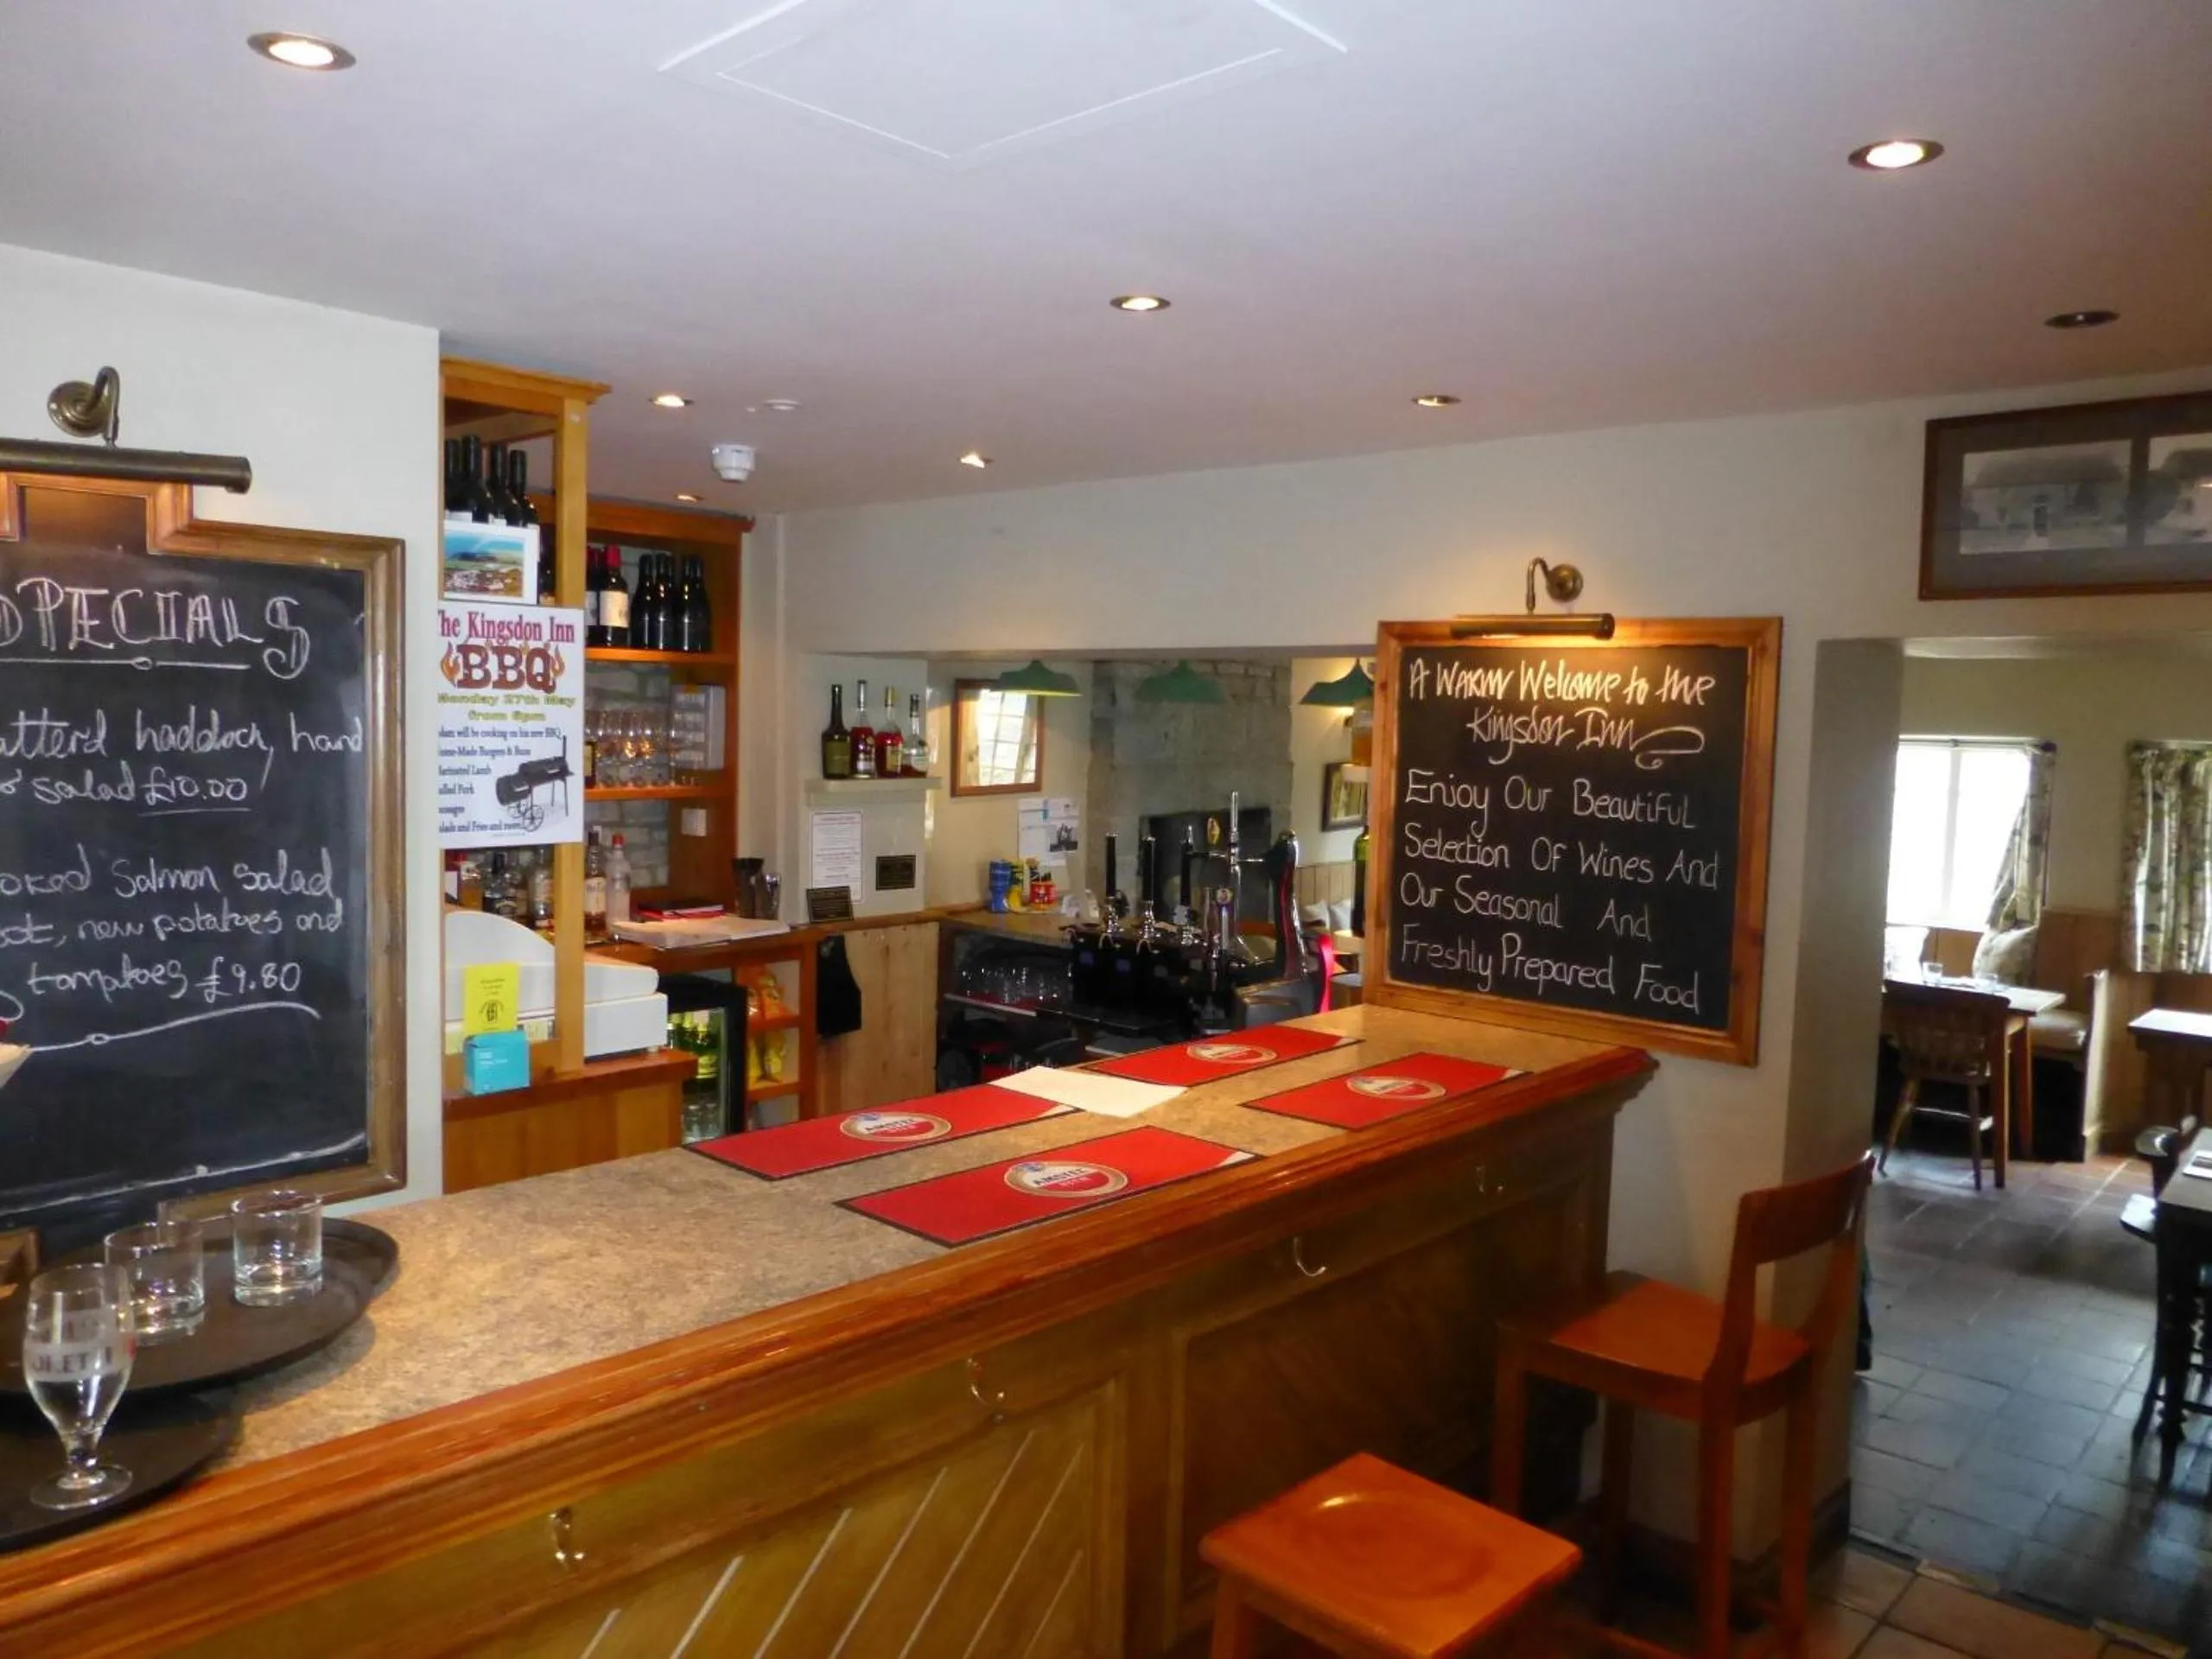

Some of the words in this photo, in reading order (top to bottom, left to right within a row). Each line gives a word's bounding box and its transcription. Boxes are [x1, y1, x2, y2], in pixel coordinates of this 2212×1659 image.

[467, 611, 543, 645] Kingsdon
[549, 615, 575, 643] Inn
[455, 644, 557, 694] BBQ
[1409, 658, 1430, 701] A
[1519, 659, 1622, 703] Welcome
[1623, 665, 1649, 705] to
[289, 711, 363, 753] hand
[32, 760, 135, 804] salad
[140, 766, 248, 805] £10.00
[1405, 768, 1491, 837] Enjoy
[1504, 775, 1552, 811] Our
[1404, 822, 1510, 868] Selection
[1578, 842, 1654, 885] Wines
[1666, 849, 1719, 891] And
[296, 898, 343, 933] and
[1400, 873, 1444, 908] Our
[1453, 874, 1564, 930] Seasonal
[1597, 898, 1653, 943] And
[1401, 923, 1494, 993] Freshly
[1500, 932, 1616, 997] Prepared
[1633, 963, 1700, 1015] Food
